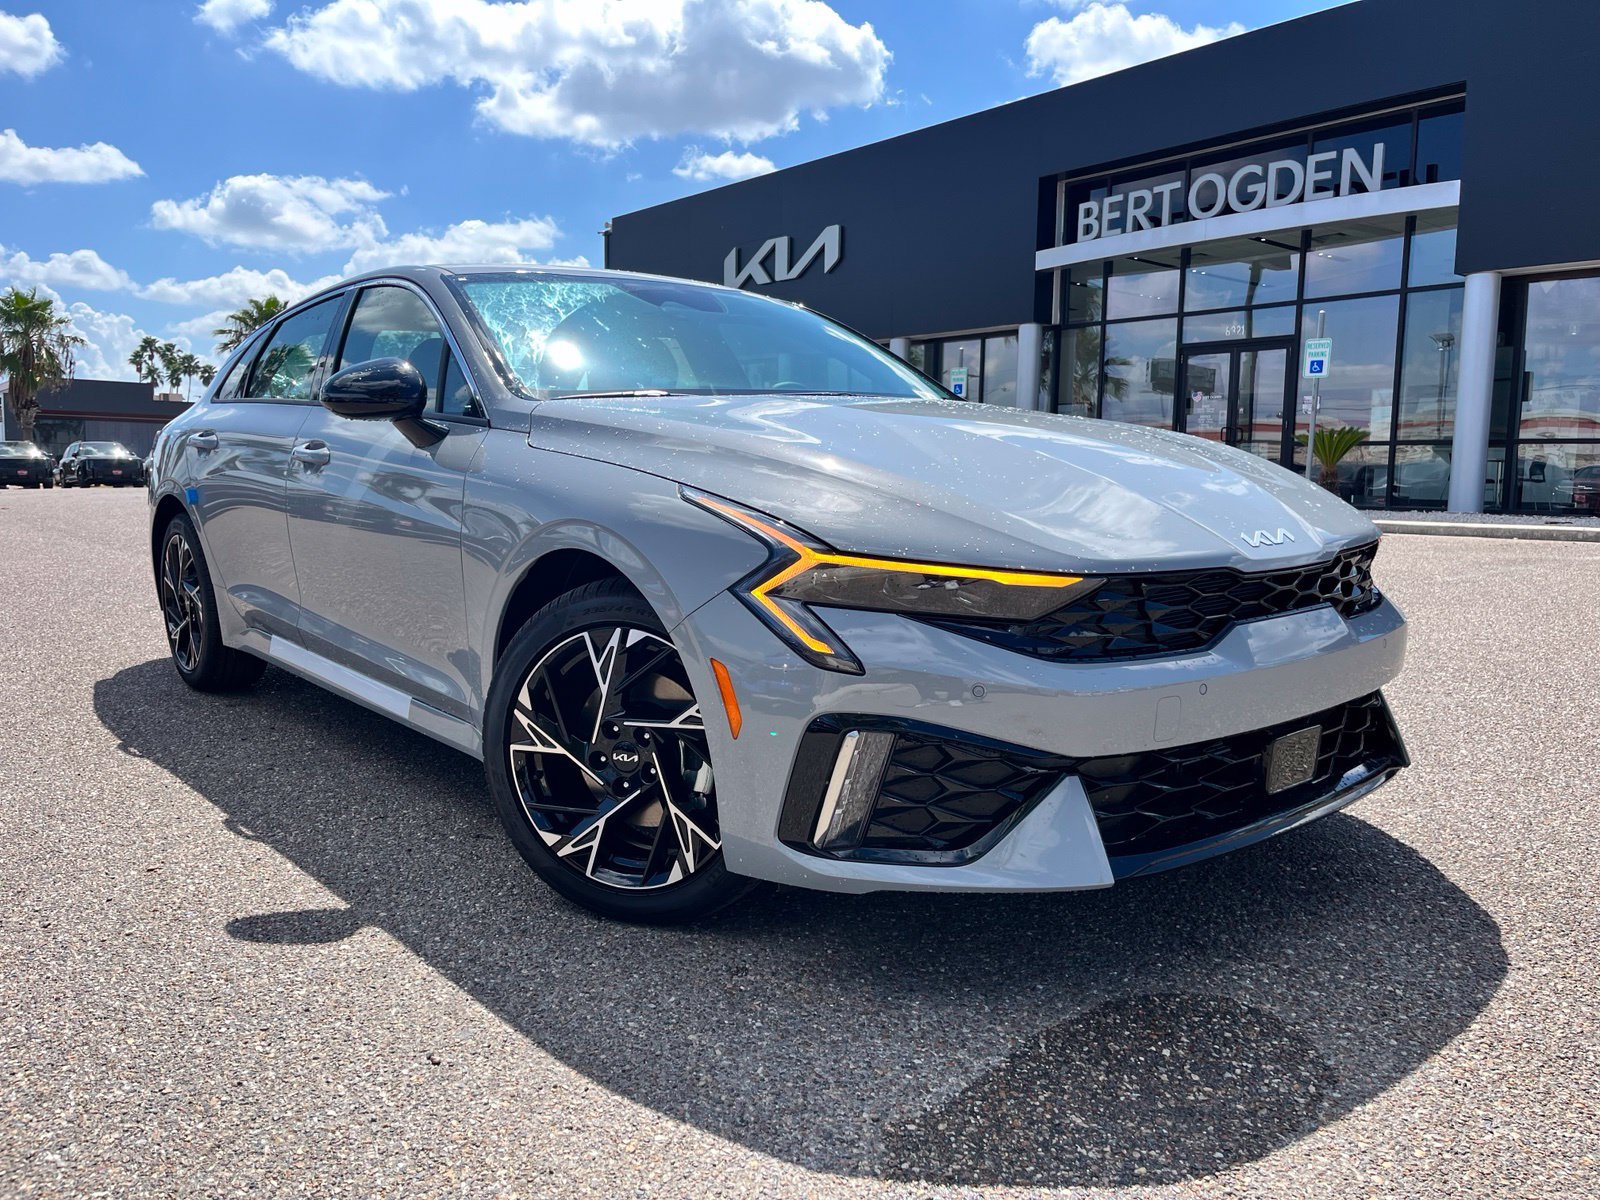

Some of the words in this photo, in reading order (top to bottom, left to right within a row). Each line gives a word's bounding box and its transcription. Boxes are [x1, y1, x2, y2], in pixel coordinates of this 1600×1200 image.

[1077, 181, 1181, 243] BERT
[1187, 142, 1385, 219] OGDEN
[723, 224, 840, 289] KIA
[1240, 527, 1295, 547] KIA
[612, 752, 639, 762] KIA
